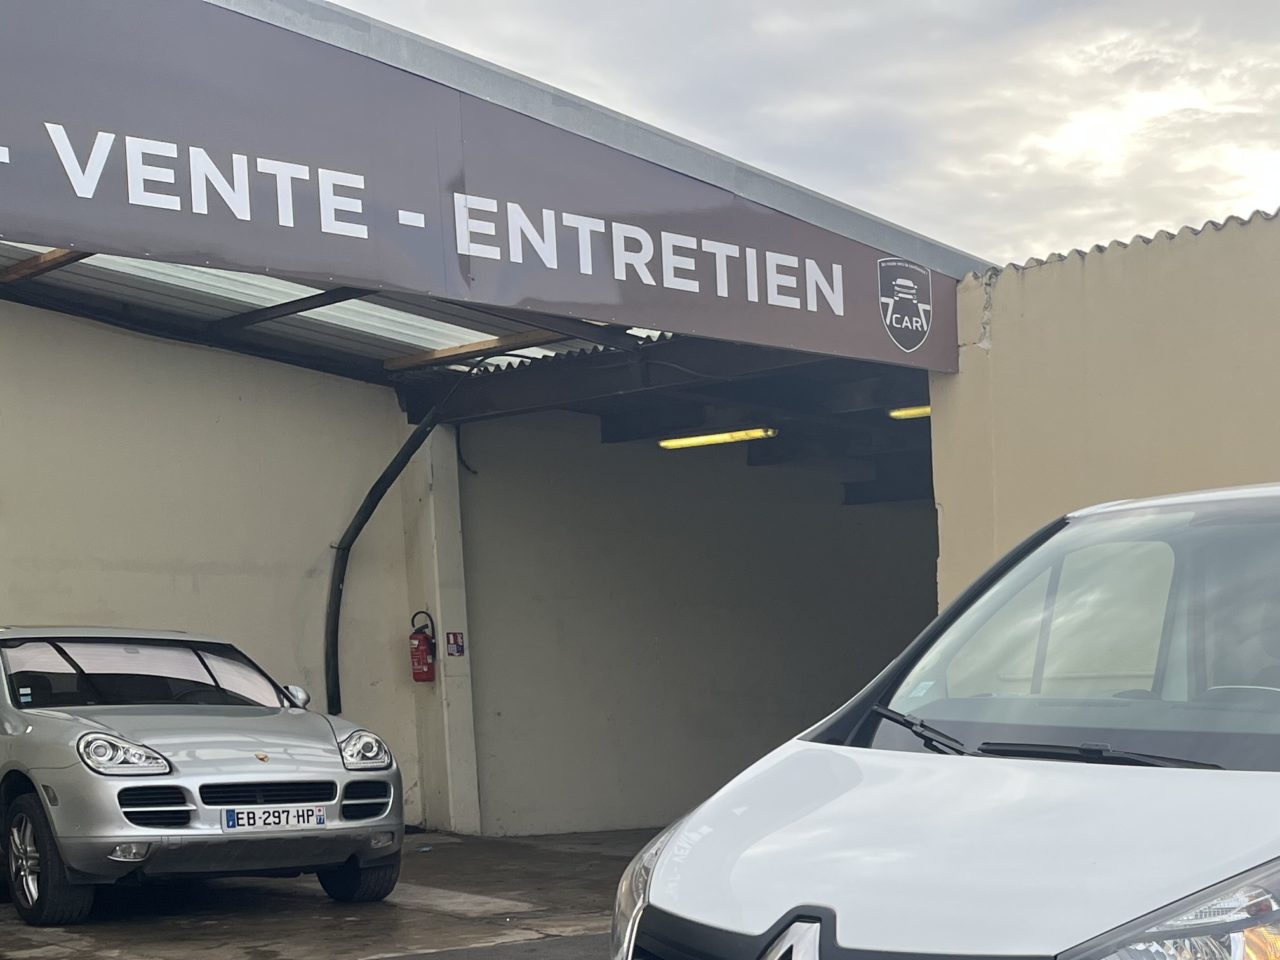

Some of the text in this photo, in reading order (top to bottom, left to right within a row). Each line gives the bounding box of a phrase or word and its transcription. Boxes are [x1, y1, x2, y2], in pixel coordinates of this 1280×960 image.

[44, 122, 369, 239] VENTE
[453, 192, 844, 316] ENTRETIEN
[236, 809, 314, 826] EB-297-HP
